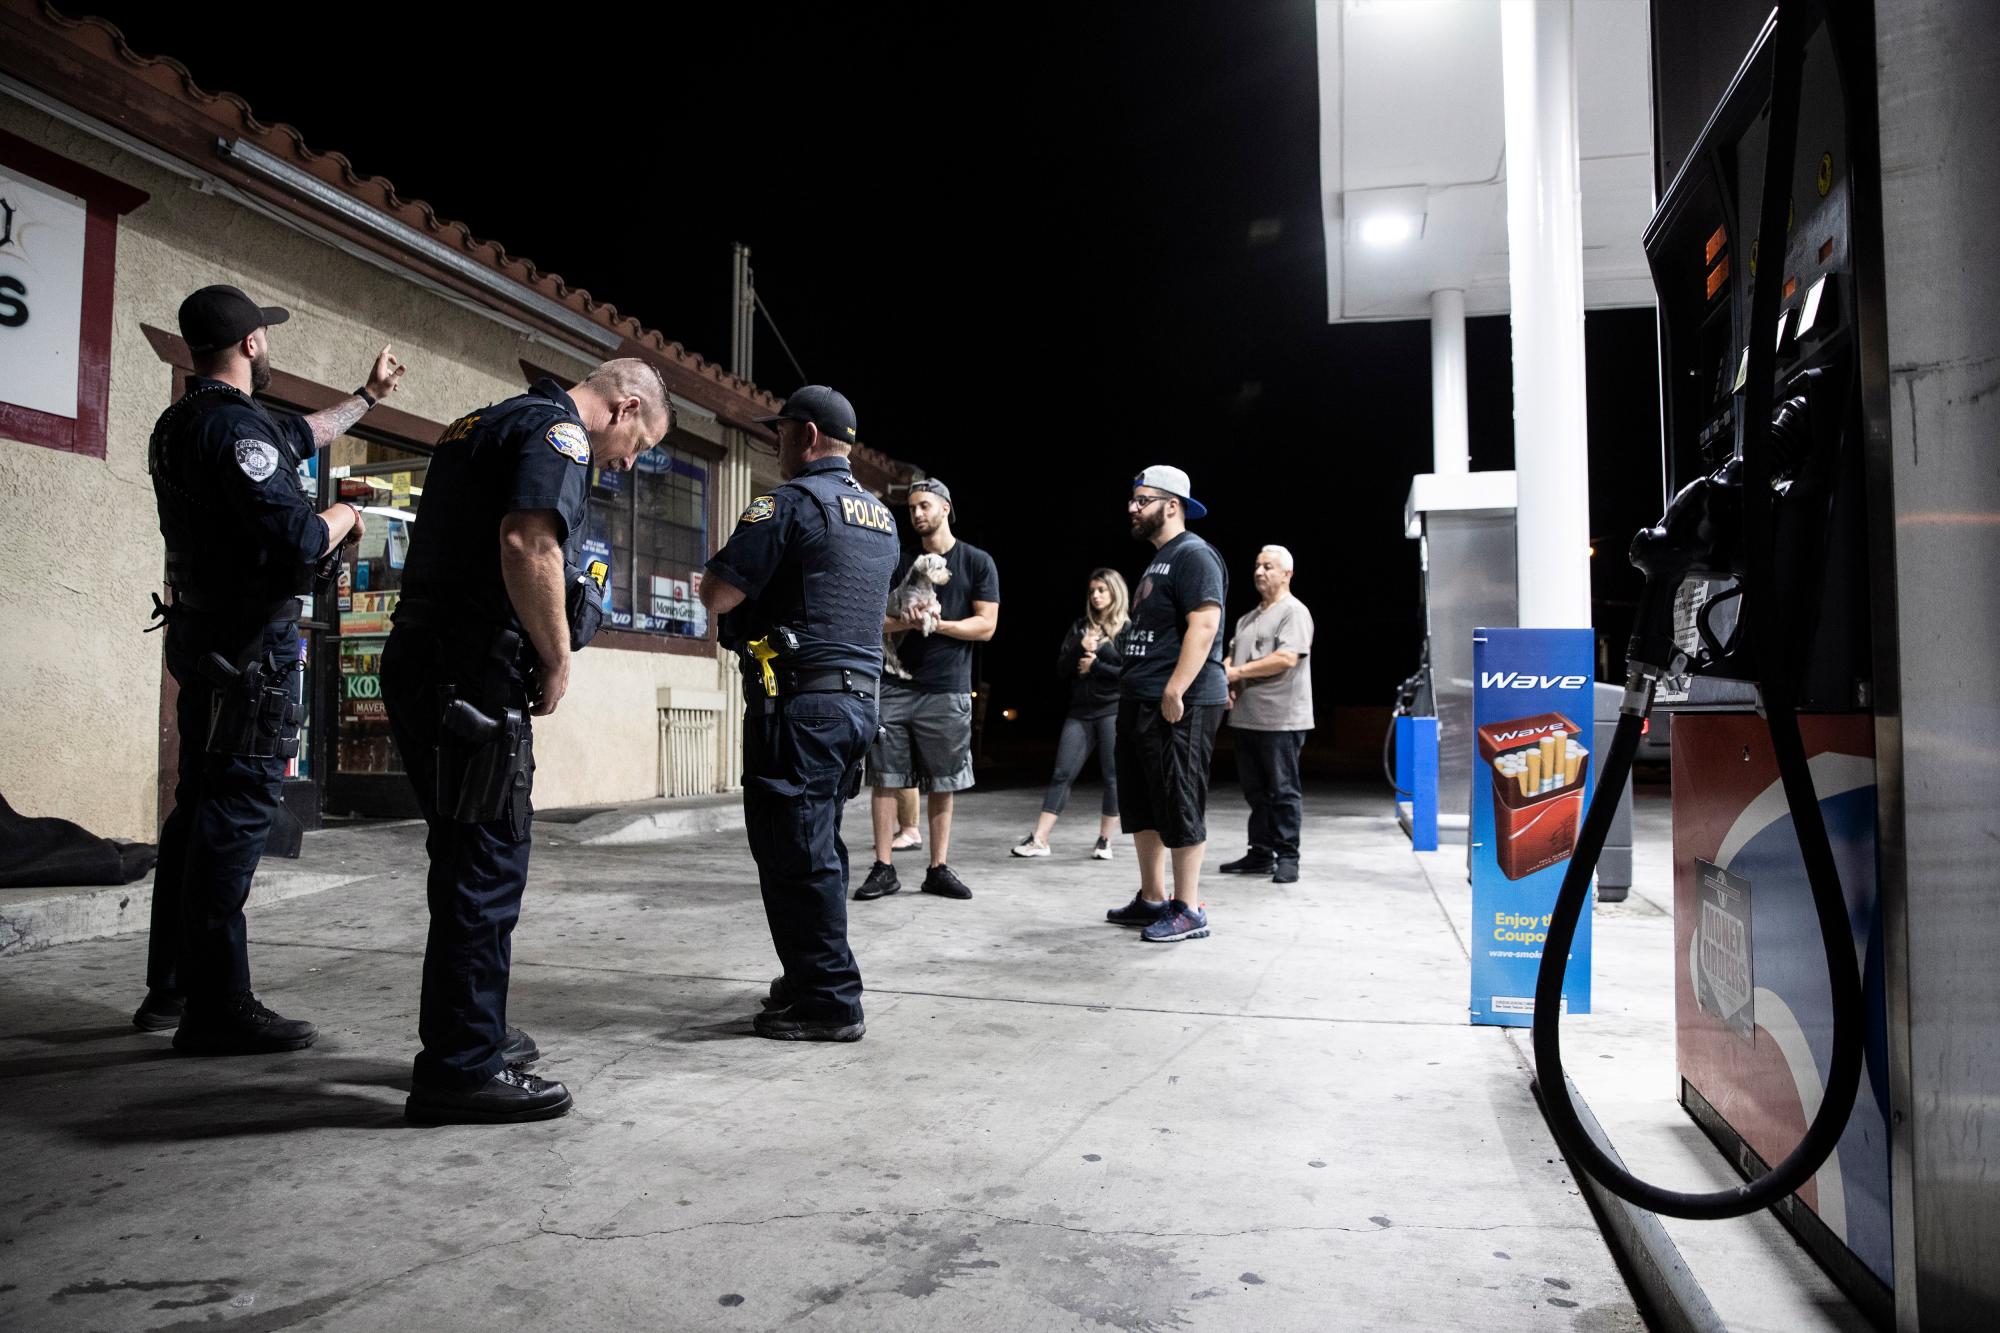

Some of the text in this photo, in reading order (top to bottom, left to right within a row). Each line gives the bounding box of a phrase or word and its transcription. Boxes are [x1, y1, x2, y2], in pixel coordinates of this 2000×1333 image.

[842, 497, 893, 532] POLICE
[347, 676, 382, 698] KOO
[1481, 671, 1588, 690] Wave
[356, 703, 387, 713] MAVER
[1493, 721, 1565, 743] Wave
[1495, 912, 1539, 930] Enjoy
[1493, 928, 1548, 945] Coupo
